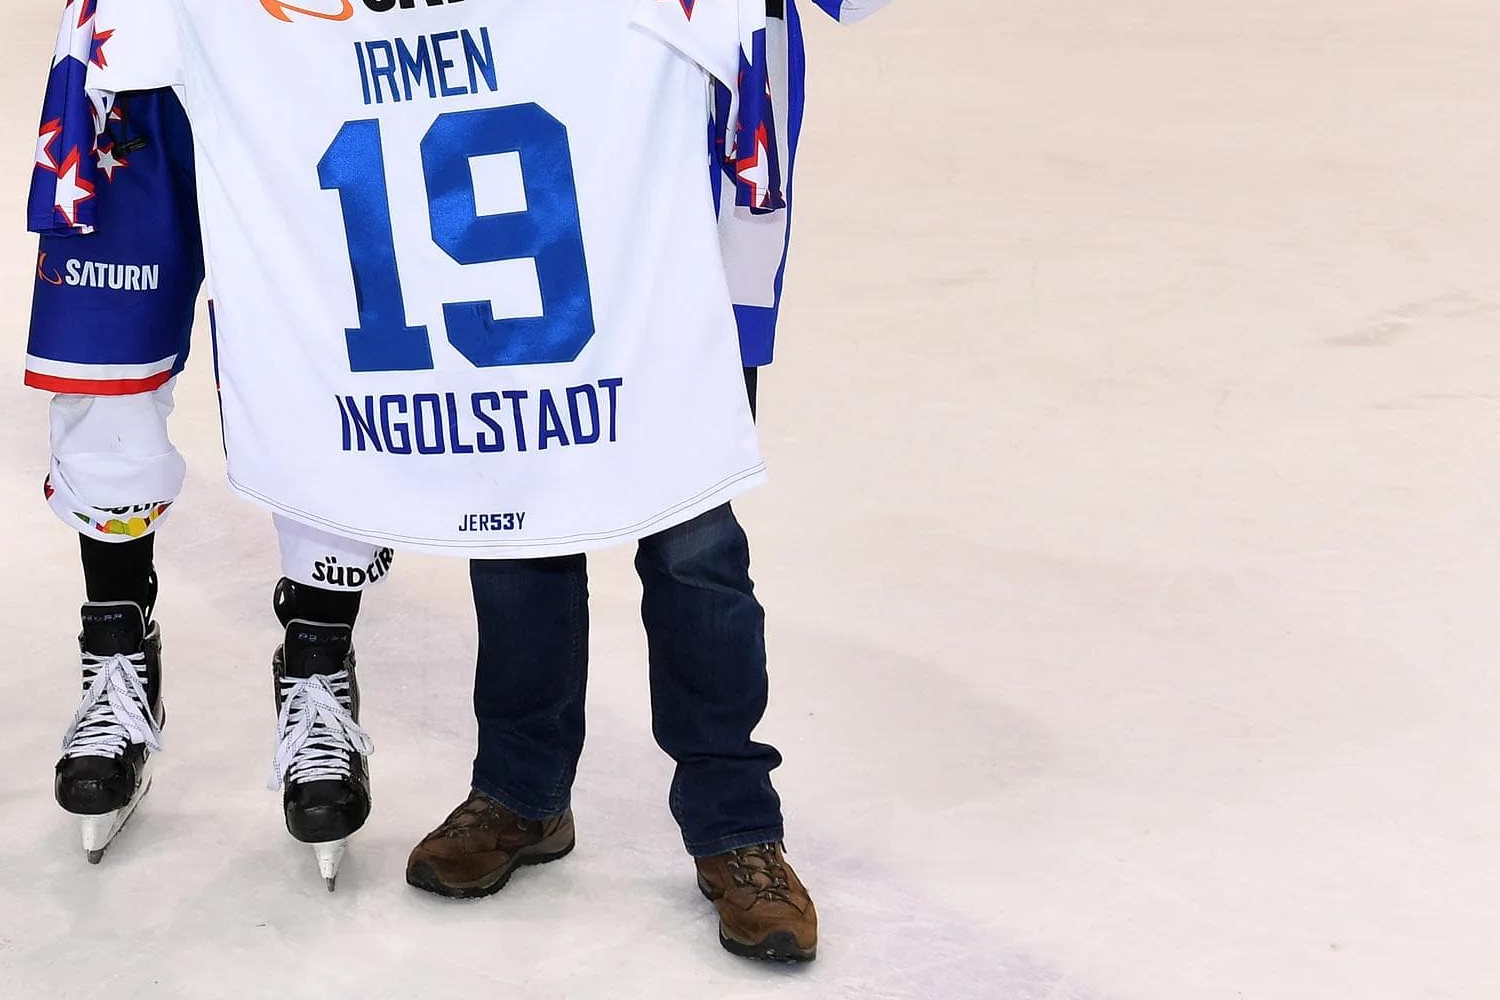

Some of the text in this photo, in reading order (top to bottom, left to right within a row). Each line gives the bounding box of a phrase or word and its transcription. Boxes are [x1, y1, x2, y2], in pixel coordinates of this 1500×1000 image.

[354, 26, 500, 106] IRMEN
[65, 258, 160, 292] SATURN
[316, 101, 596, 373] 19
[335, 376, 624, 456] INGOLSTADT
[458, 511, 526, 533] JER53Y
